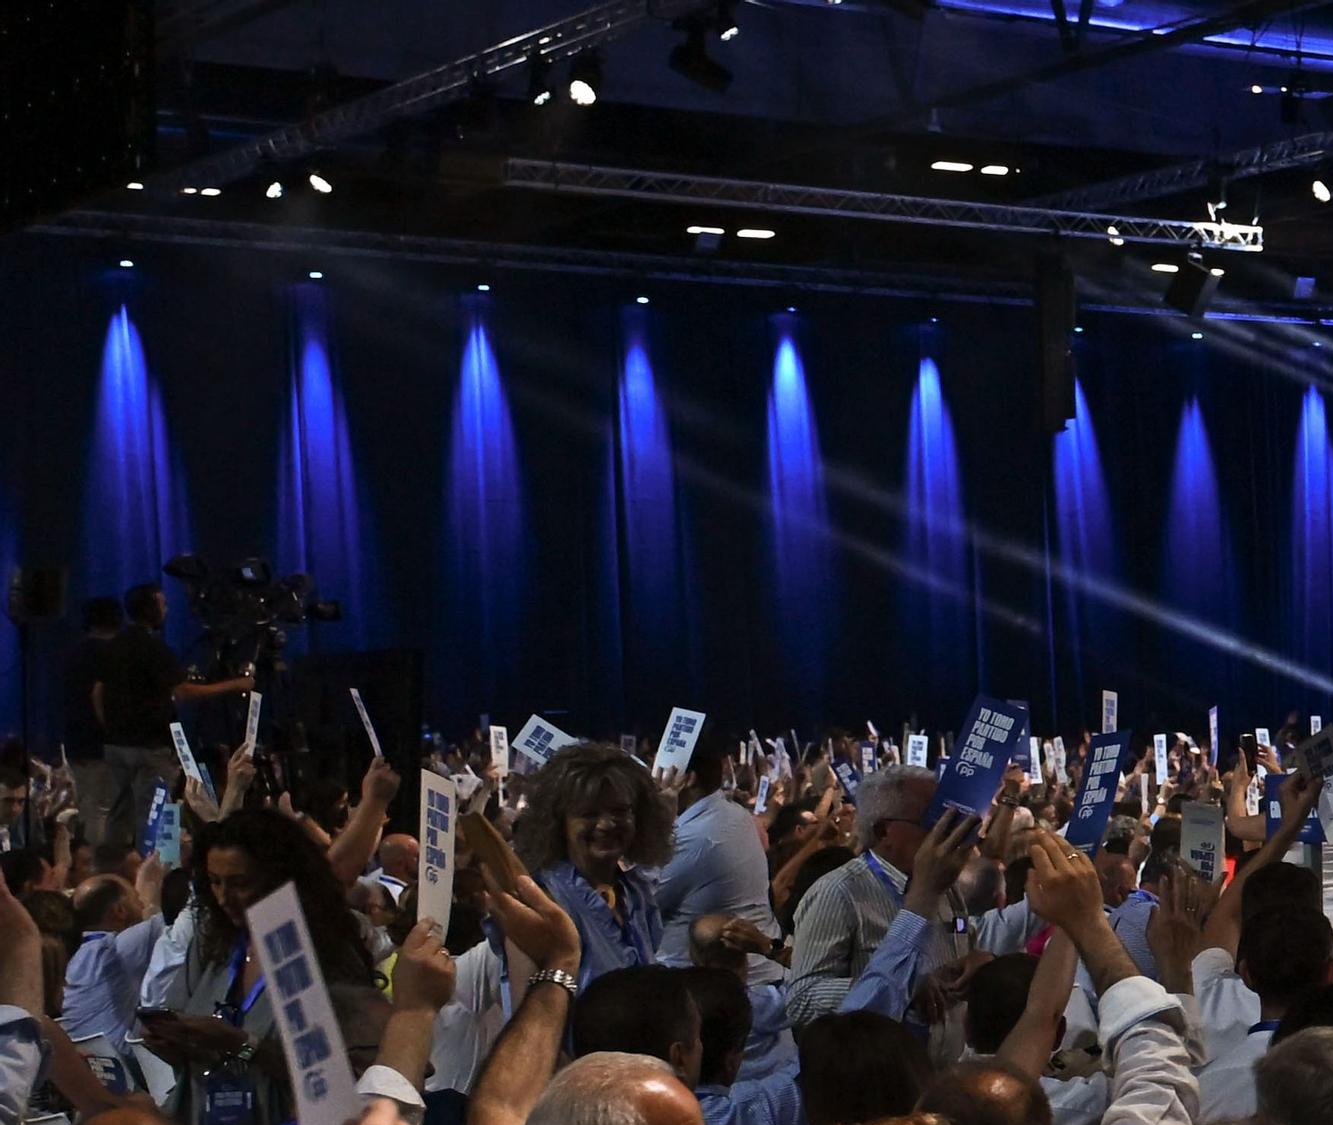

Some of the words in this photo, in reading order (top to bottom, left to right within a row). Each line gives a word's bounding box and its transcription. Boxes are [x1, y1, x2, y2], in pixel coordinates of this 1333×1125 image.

[979, 707, 992, 722] YO
[990, 711, 1015, 730] TOMO
[966, 733, 986, 750] POR
[971, 720, 1009, 743] PARTIDO
